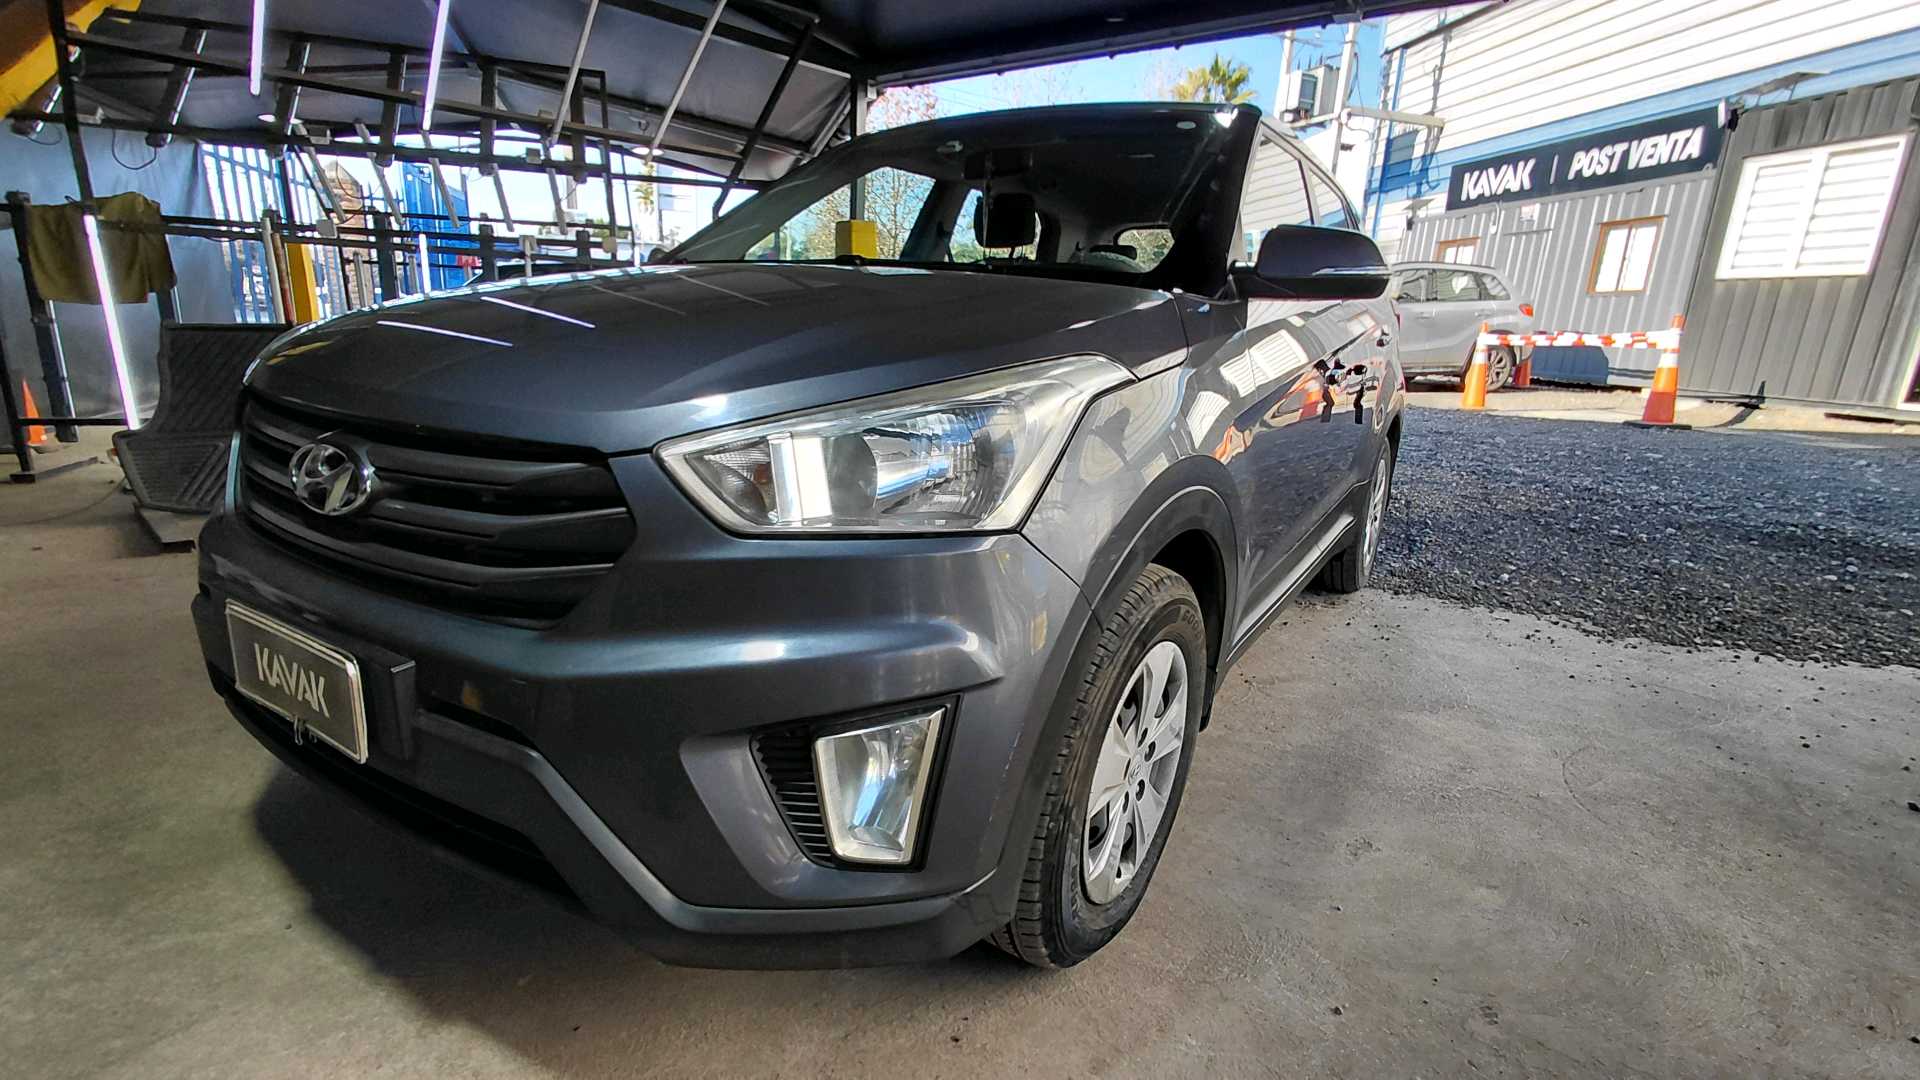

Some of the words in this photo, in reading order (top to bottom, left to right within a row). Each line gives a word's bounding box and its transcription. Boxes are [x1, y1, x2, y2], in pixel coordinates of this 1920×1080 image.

[1460, 158, 1537, 201] KAVAK
[1567, 142, 1629, 180] POST
[1627, 126, 1705, 171] VENTA
[254, 643, 330, 719] KAVAK
